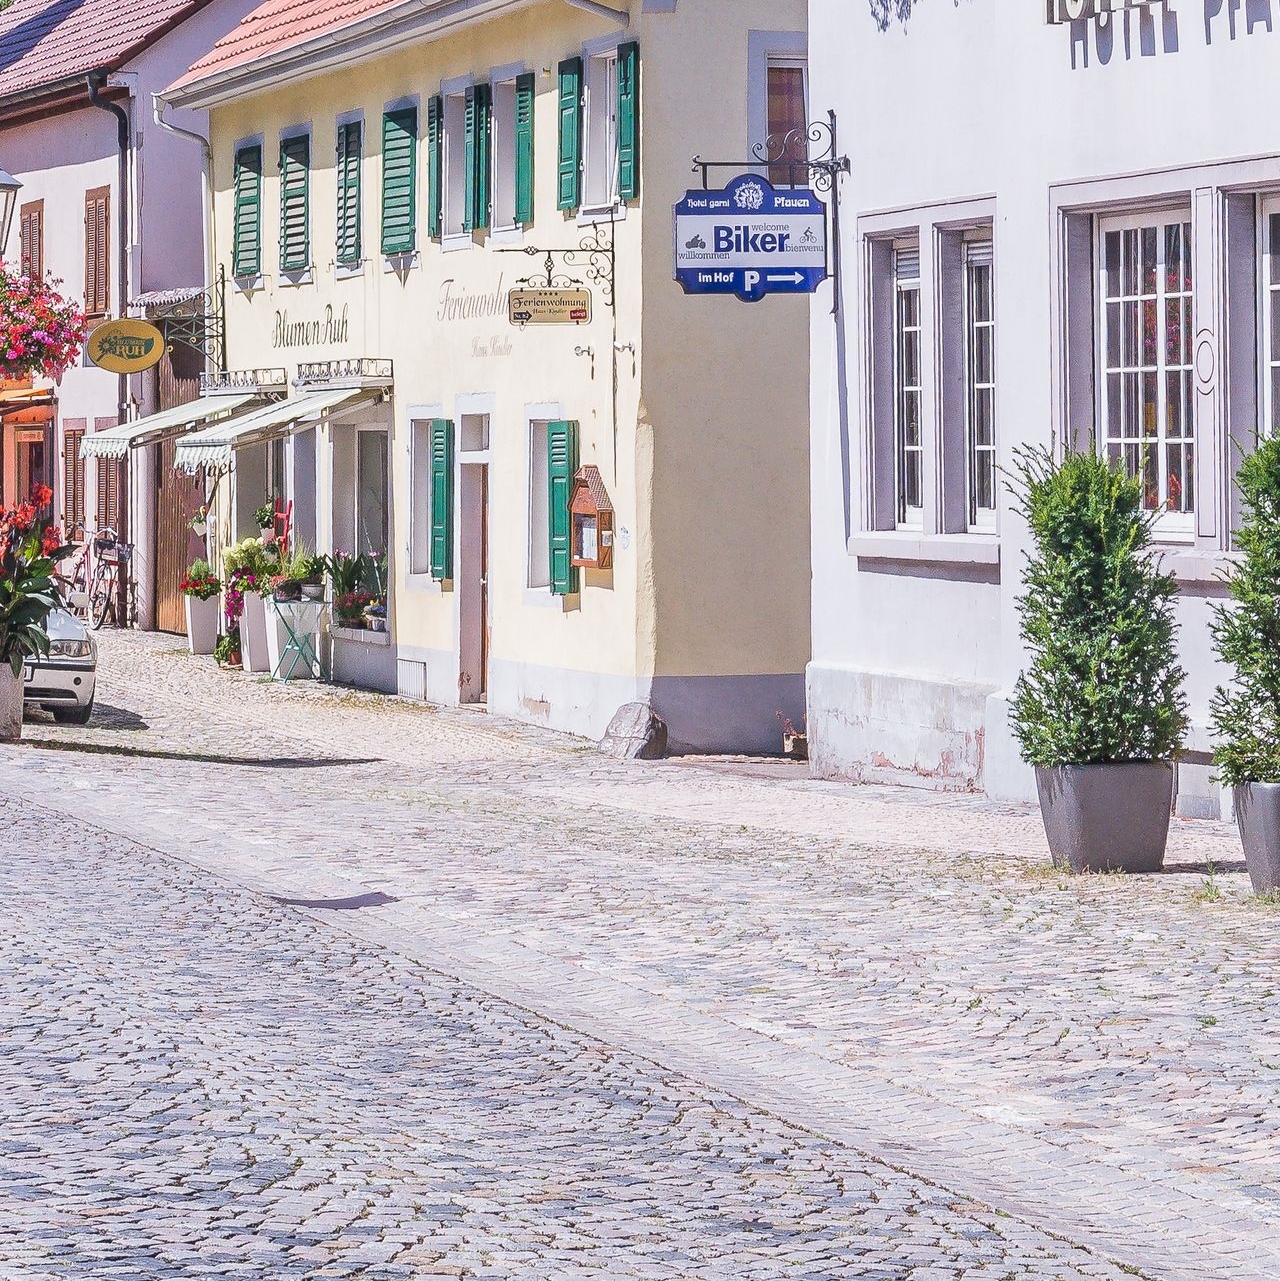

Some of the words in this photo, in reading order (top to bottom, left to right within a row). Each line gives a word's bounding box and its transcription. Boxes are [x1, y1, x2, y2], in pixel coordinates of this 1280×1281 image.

[687, 199, 707, 208] Hotel
[710, 199, 730, 208] garni
[774, 197, 809, 207] Pfauen
[752, 223, 789, 231] welcome
[714, 226, 790, 253] Biker
[785, 244, 824, 252] bienvenu
[699, 273, 712, 282] im
[714, 272, 734, 282] Hof
[744, 271, 760, 291] P
[512, 297, 586, 309] Ferienwohnung
[272, 309, 320, 348] Blumen
[321, 303, 349, 344] Ruh
[116, 345, 145, 359] RUH
